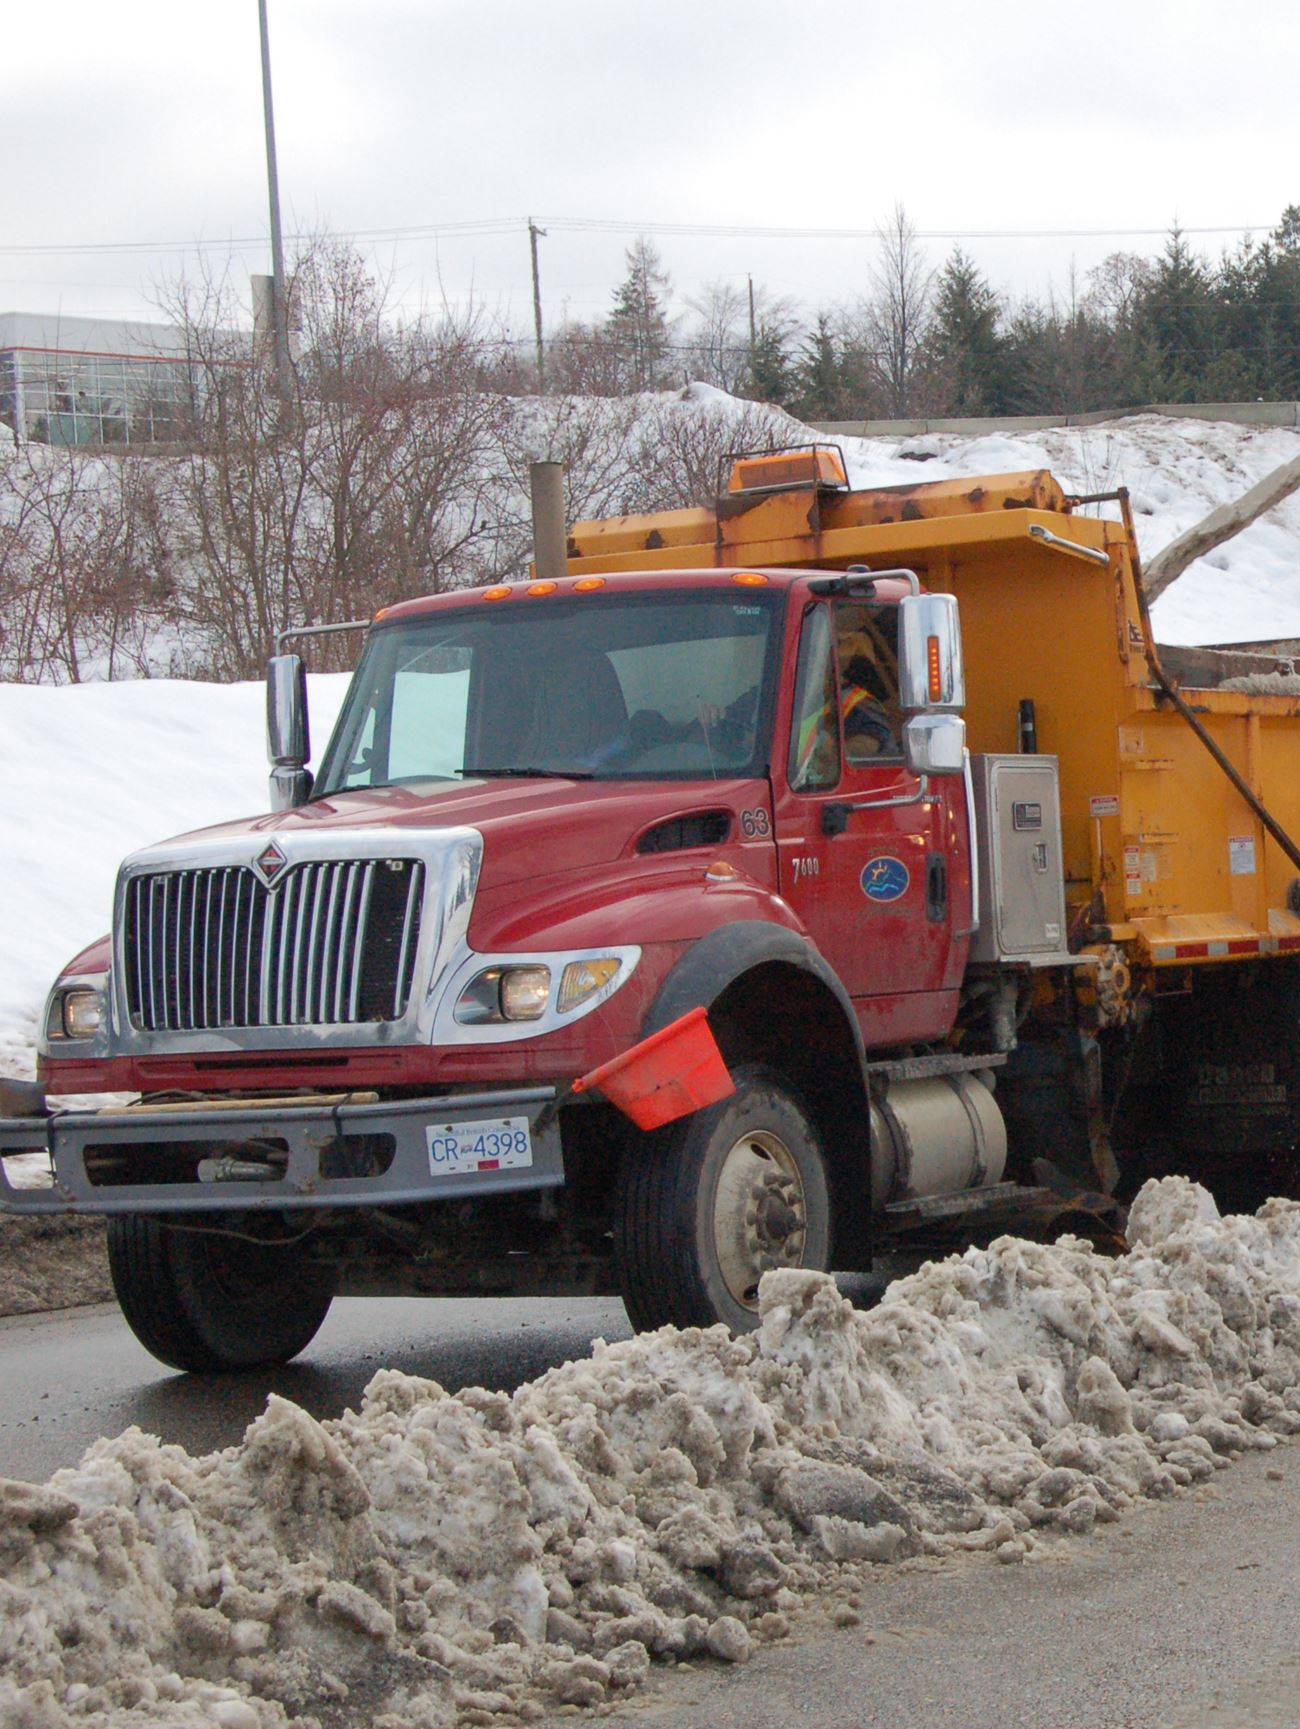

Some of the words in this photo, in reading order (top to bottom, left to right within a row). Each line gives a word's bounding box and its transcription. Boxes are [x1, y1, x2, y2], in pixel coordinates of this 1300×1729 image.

[741, 807, 770, 836] 63
[791, 857, 820, 885] 7600
[431, 1137, 459, 1162] CR
[474, 1131, 528, 1157] 4398
